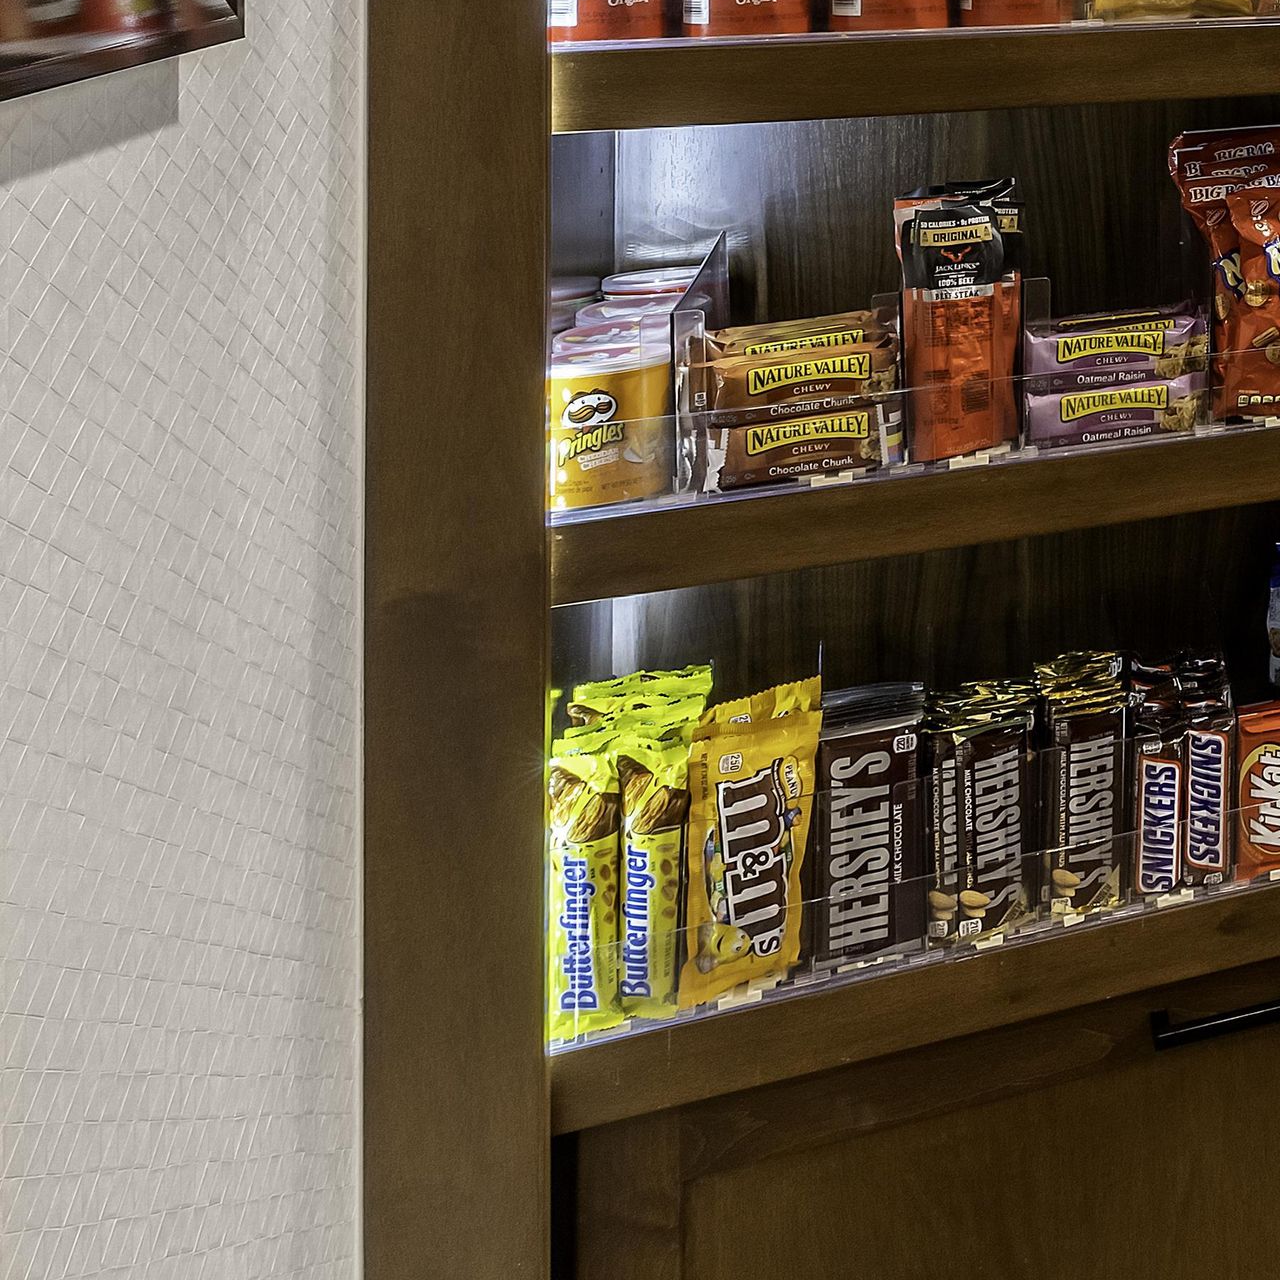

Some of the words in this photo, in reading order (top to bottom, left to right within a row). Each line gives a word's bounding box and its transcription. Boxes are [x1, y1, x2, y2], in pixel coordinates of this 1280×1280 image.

[933, 228, 982, 243] ORIGINAL
[1063, 336, 1113, 358] NATURE
[1115, 333, 1160, 351] VALLEY
[1096, 356, 1129, 365] CHEWY
[753, 364, 812, 391] NATURE
[814, 354, 865, 376] VALLEY
[1077, 372, 1116, 384] Oatmeal
[1118, 370, 1146, 381] Raisin
[793, 383, 831, 395] CHEWY
[770, 401, 820, 416] Chocolate
[823, 395, 854, 410] Chunk
[1065, 395, 1117, 417] NATURE
[1119, 387, 1165, 406] VALLEY
[1100, 413, 1134, 422] CHEWY
[752, 423, 811, 450] NATURE
[813, 414, 865, 435] VALLEY
[1082, 431, 1122, 442] Oatmeal
[1124, 425, 1152, 436] Raisin
[557, 422, 625, 468] Pringles
[792, 442, 831, 455] CHEWY
[769, 461, 819, 476] Chocolate
[822, 455, 854, 468] Chunk
[1189, 735, 1221, 865] SNICKERS
[1142, 763, 1177, 893] SNICKERS
[829, 752, 892, 951] HERSHEY'S
[619, 843, 651, 999] Butterfinger
